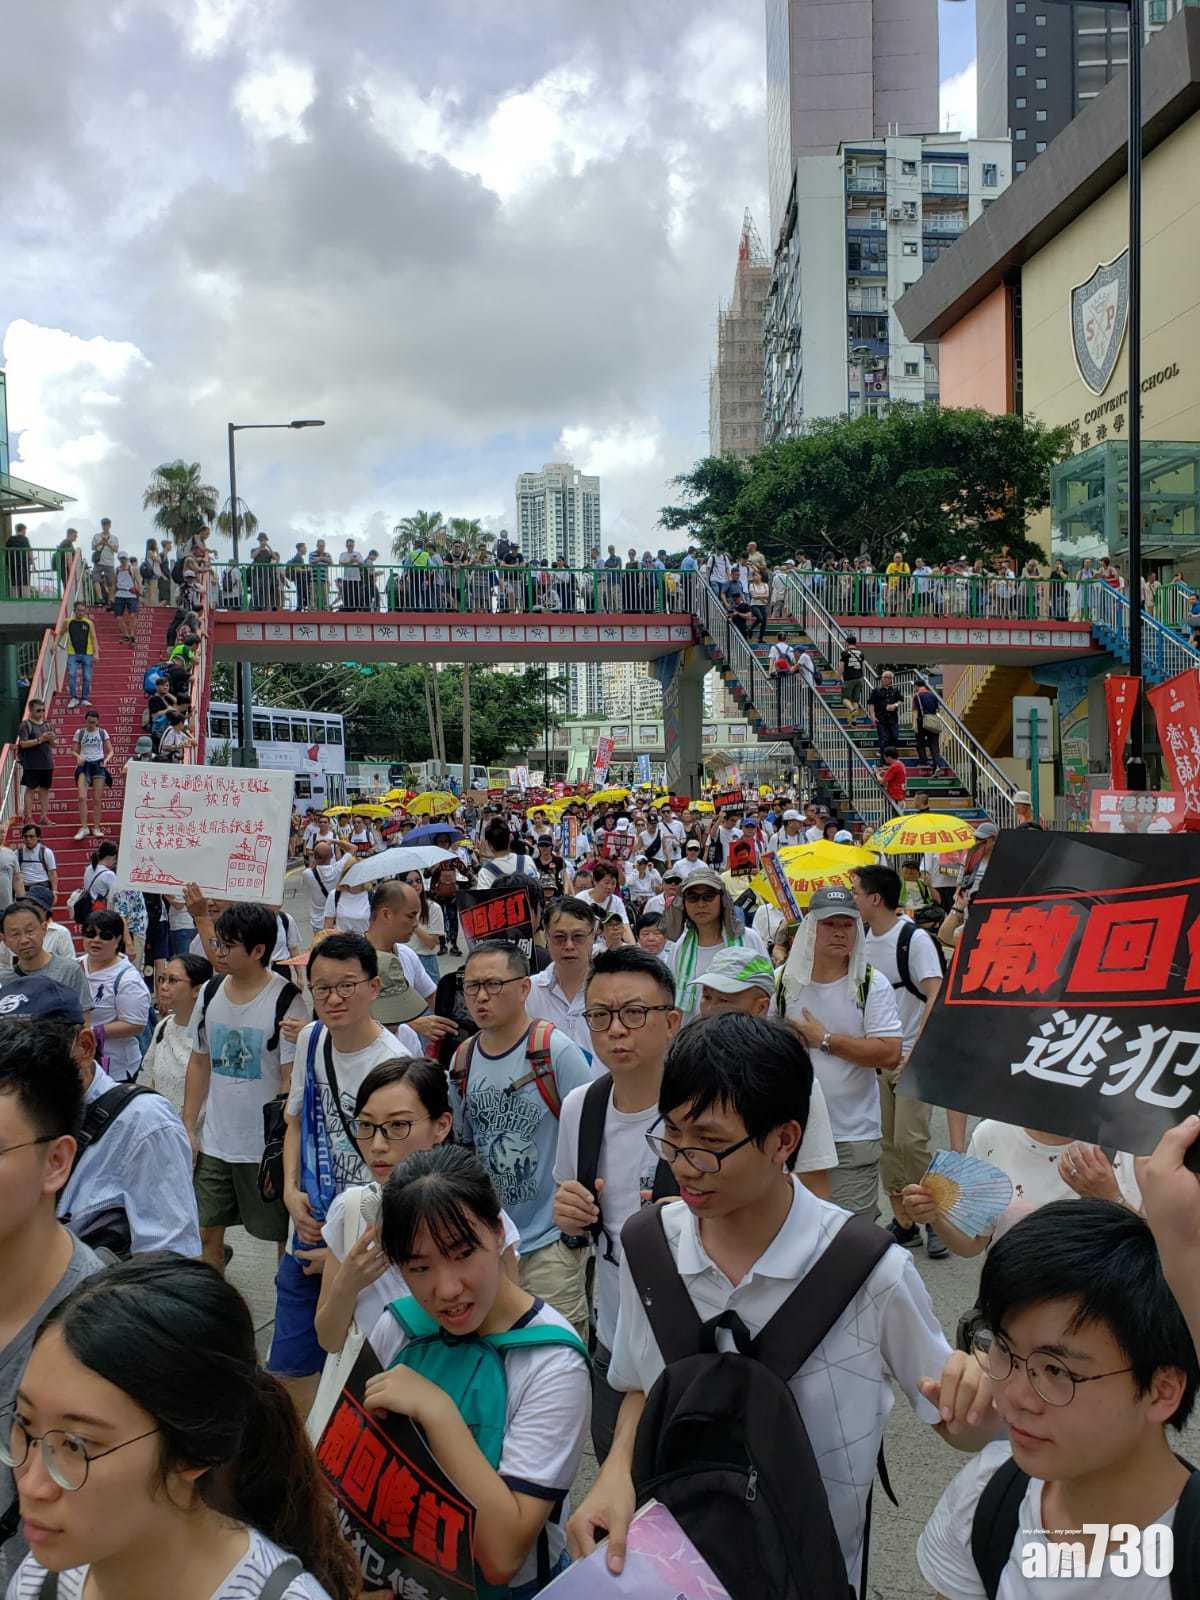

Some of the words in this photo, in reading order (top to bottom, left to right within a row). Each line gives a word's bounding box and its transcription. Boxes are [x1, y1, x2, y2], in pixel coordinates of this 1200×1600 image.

[1084, 390, 1128, 424] CONVENT
[1138, 362, 1180, 394] CHOOL
[318, 1402, 466, 1575] 撤回修訂
